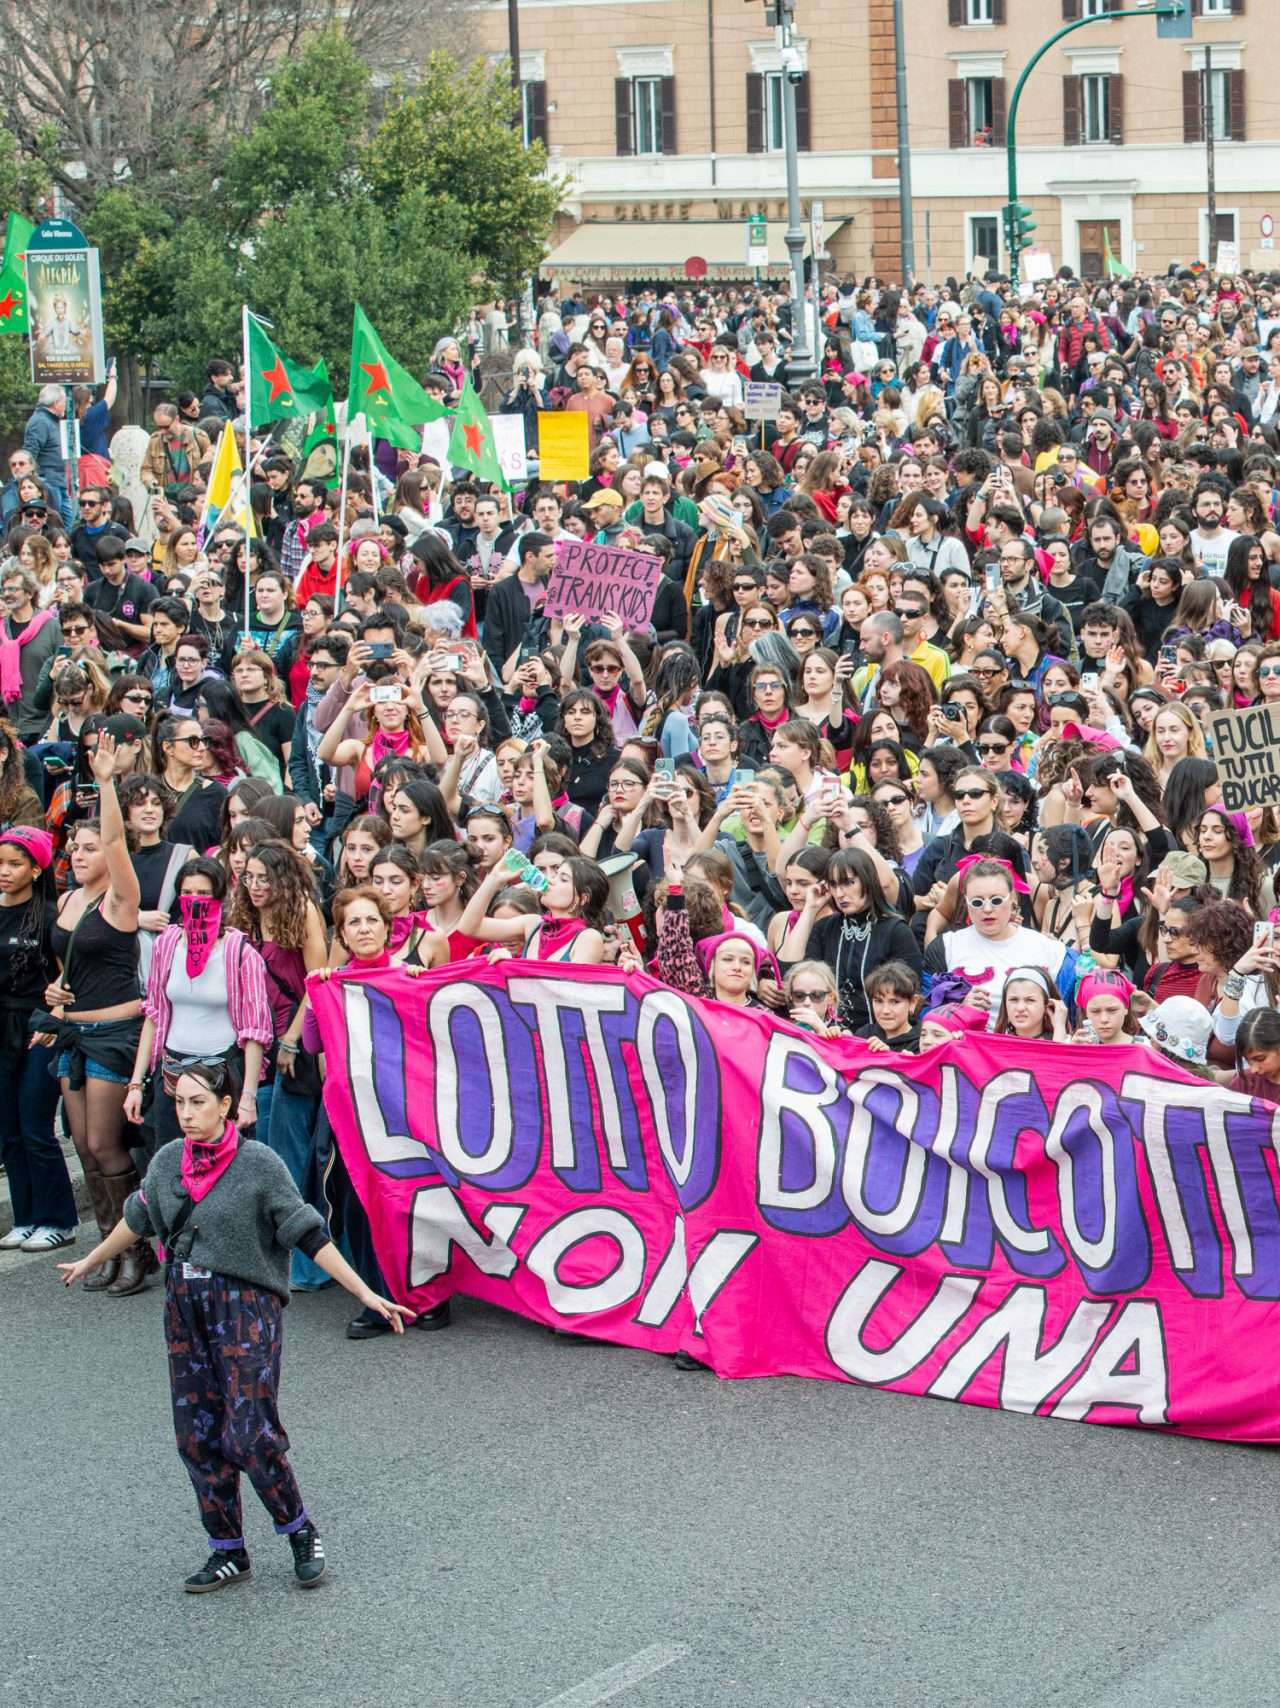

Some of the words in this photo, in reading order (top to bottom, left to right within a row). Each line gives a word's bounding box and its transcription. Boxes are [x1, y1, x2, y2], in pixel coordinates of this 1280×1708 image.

[31, 254, 54, 264] CIRQUE
[54, 254, 64, 262] DU
[65, 253, 86, 262] SOLEIL
[566, 545, 659, 582] PROTECT
[1219, 751, 1274, 780] TUTTI
[343, 977, 718, 1210] LOTTO
[409, 1185, 760, 1337] NON
[826, 1258, 1172, 1425] UNA
